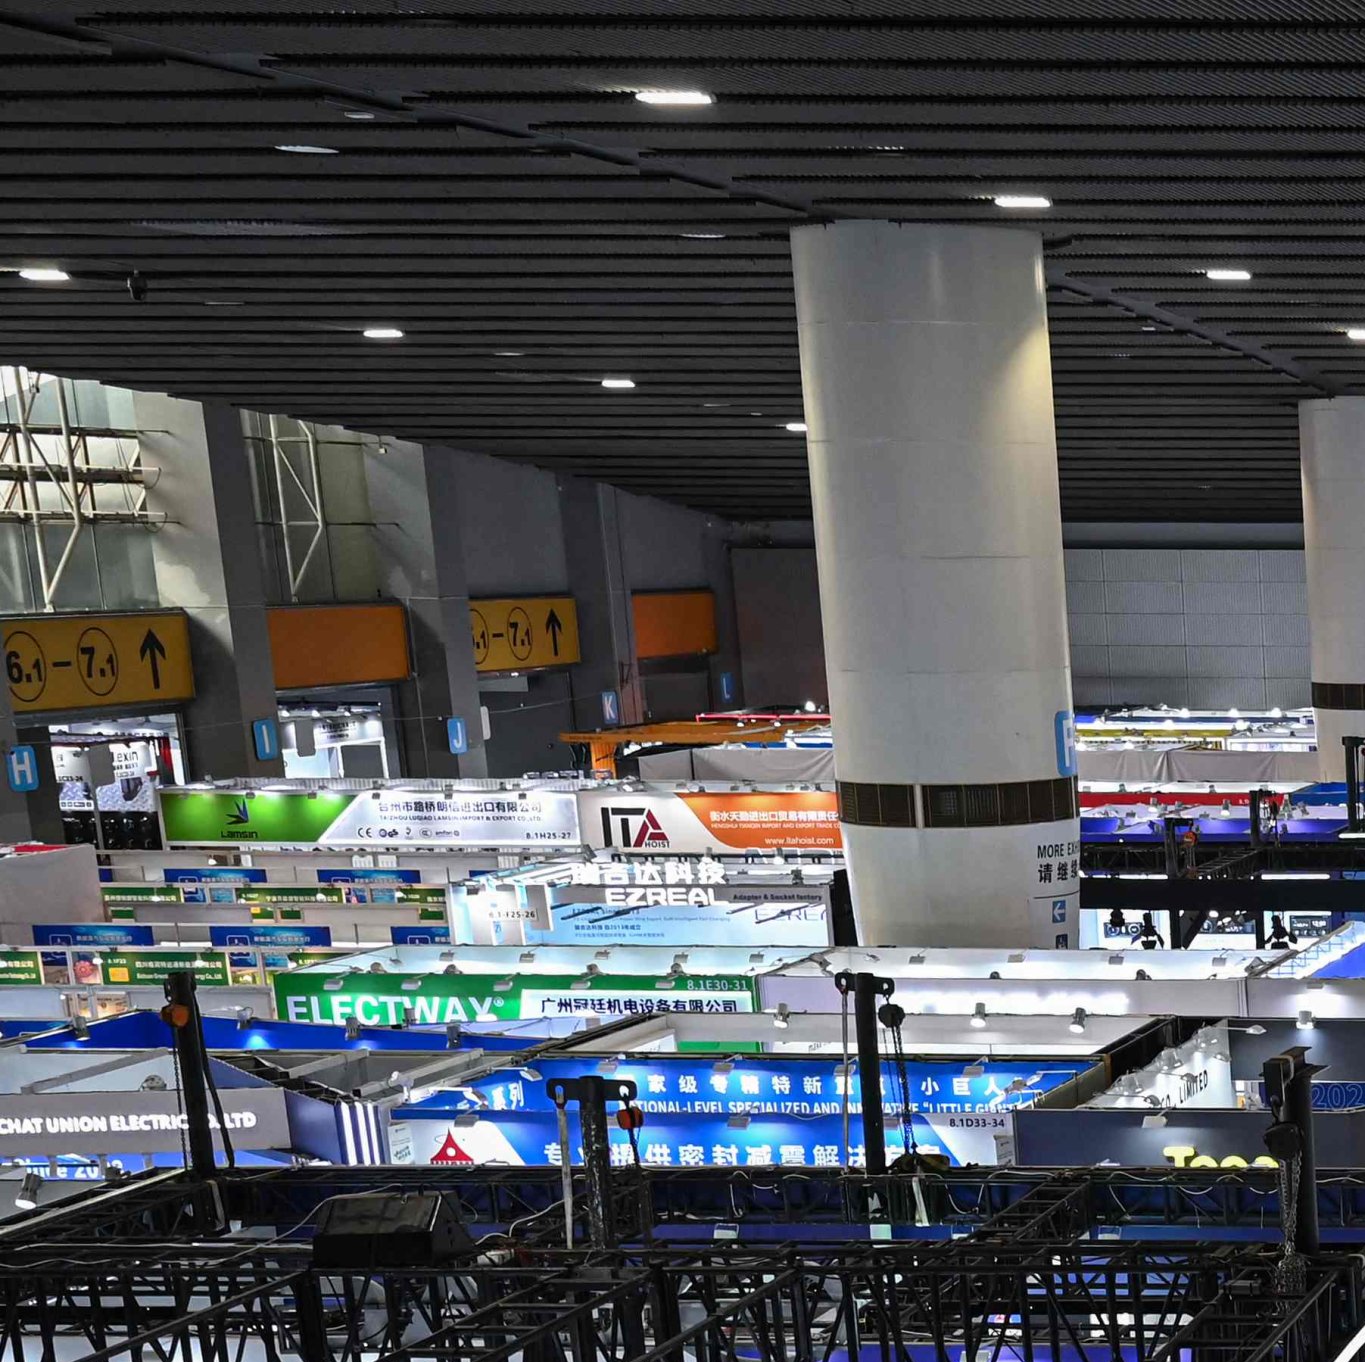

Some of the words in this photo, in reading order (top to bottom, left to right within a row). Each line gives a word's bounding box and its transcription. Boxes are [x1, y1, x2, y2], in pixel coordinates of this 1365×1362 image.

[510, 622, 531, 646] 7.1
[6, 650, 43, 685] 6.1
[80, 646, 115, 678] 7.1
[604, 694, 616, 720] K
[453, 726, 463, 748] J
[12, 761, 34, 786] H
[526, 832, 571, 840] 8.1H25-27
[645, 841, 670, 849] HOIST
[1037, 845, 1064, 860] MORE
[605, 887, 729, 906] EZREAL
[733, 893, 761, 901] Adapter
[686, 979, 748, 992] 8.1E30-31
[1178, 1069, 1208, 1105] LIMITED
[46, 1115, 107, 1133] UNION
[949, 1118, 1005, 1129] 8.1D33-34
